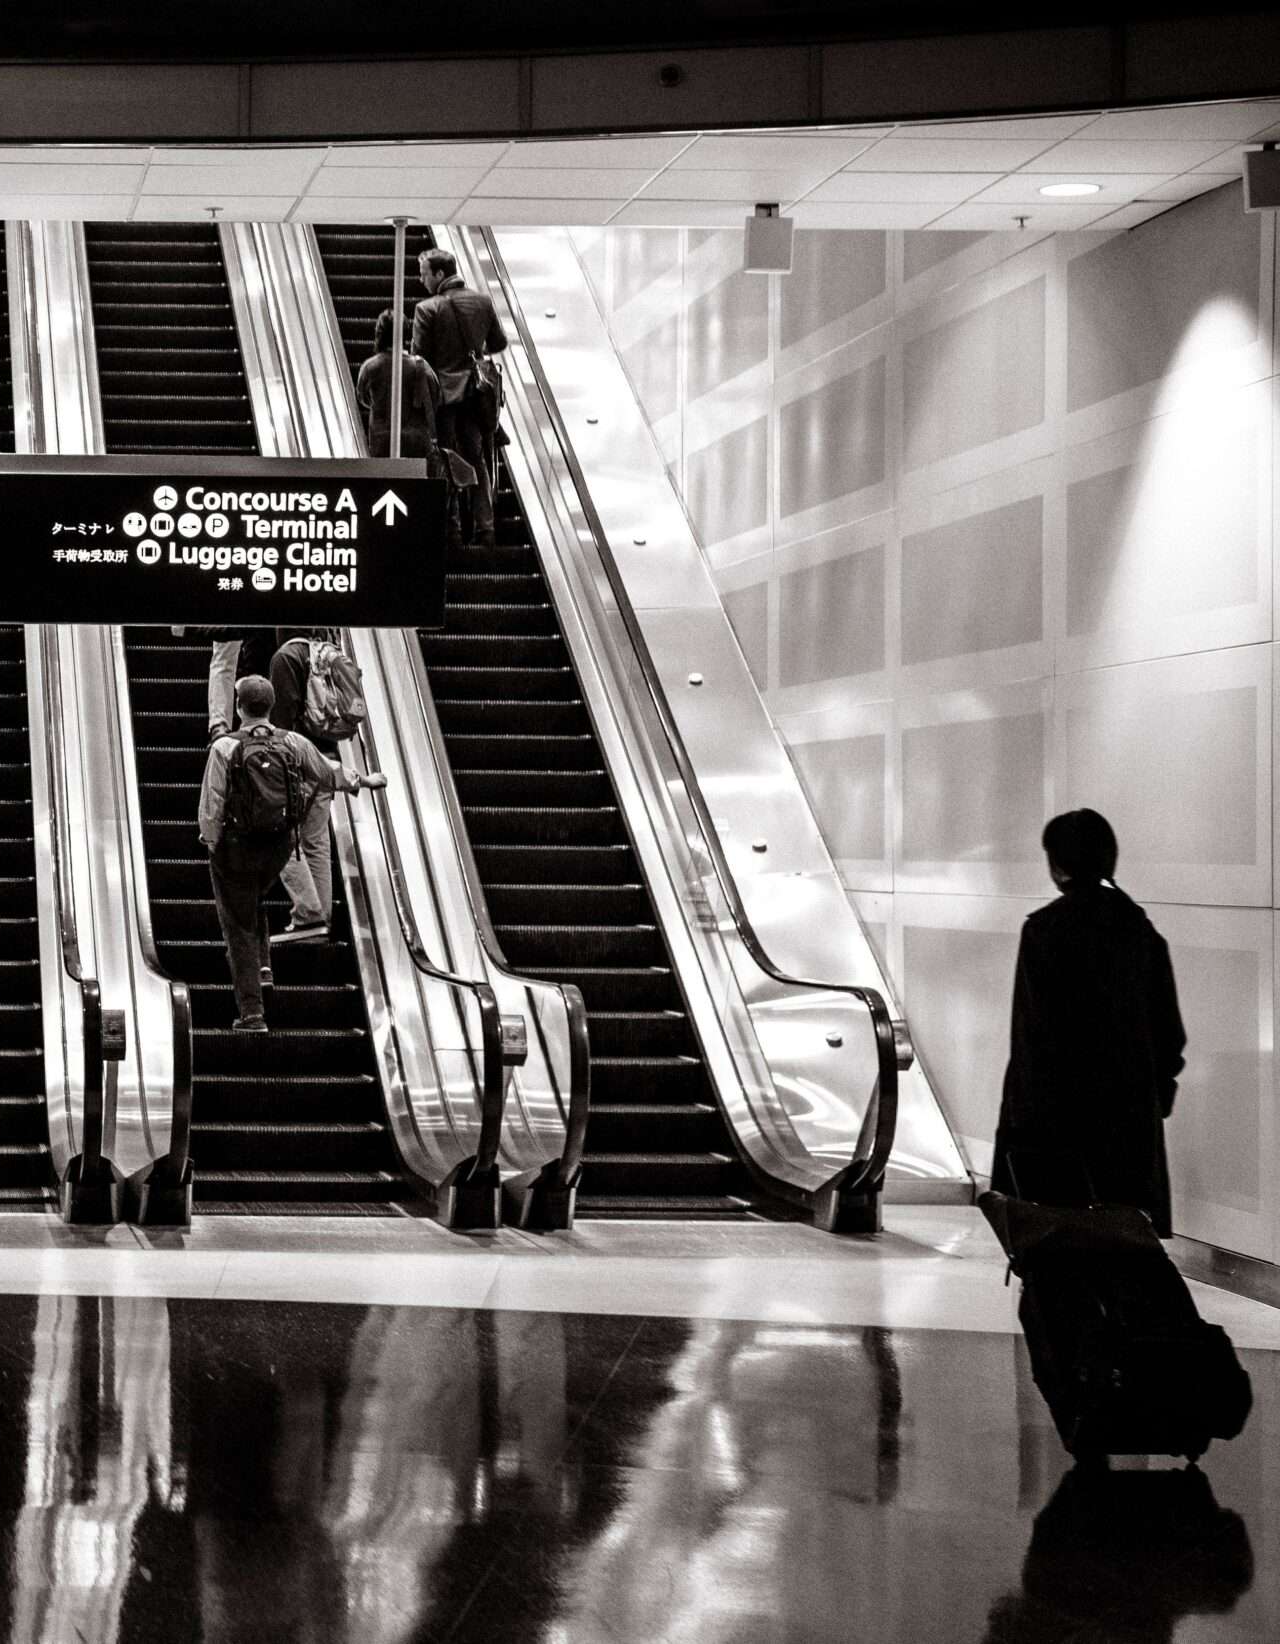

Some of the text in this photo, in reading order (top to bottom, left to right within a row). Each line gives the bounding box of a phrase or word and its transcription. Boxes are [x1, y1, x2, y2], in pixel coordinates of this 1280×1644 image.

[186, 486, 358, 511] Concourse A
[240, 514, 358, 539] Terminal
[52, 549, 129, 564] 手荷物受取所
[169, 542, 357, 571] Luggage Claim
[283, 567, 357, 592] Hotel
